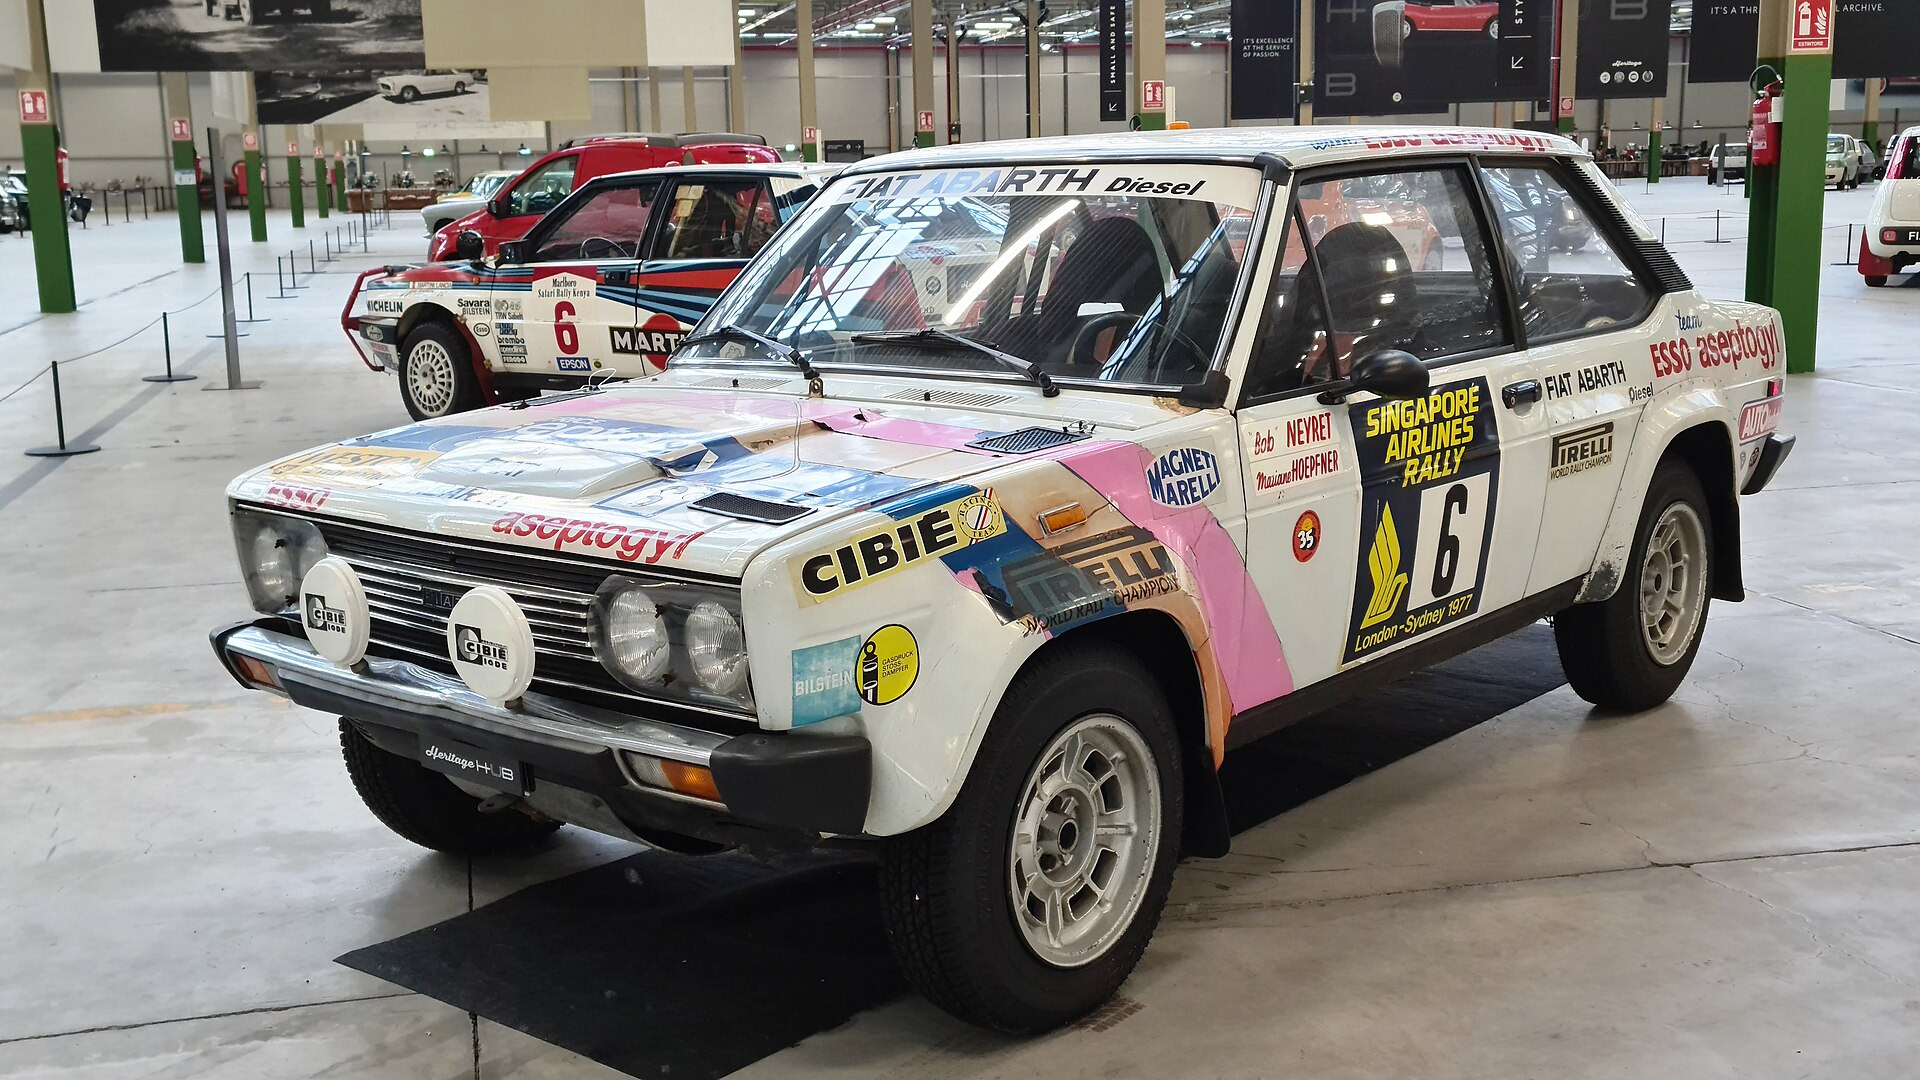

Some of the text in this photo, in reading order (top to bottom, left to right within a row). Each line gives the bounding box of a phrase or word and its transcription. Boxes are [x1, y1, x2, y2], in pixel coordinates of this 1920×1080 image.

[1710, 6, 1729, 15] IT'S
[1730, 6, 1737, 14] A
[1843, 3, 1885, 13] ARCHIVE.
[839, 167, 1206, 199] FIAT ABARTH Diesel
[1908, 231, 1920, 241] FI
[538, 288, 590, 299] Safari Rally Kenya
[552, 276, 577, 288] Marlboro
[458, 299, 490, 307] Savara
[462, 307, 491, 316] BILSTEIN
[554, 300, 579, 355] 6
[1675, 309, 1703, 331] team
[1650, 313, 1780, 378] ESSO aseptogyl
[560, 359, 588, 369] EPSON
[1545, 360, 1627, 400] FIAT ABARTH
[1628, 382, 1654, 403] Diesel
[1286, 412, 1331, 448] NEYRET
[1384, 415, 1474, 464] AIRLINES
[1551, 421, 1614, 468] PIRELLI
[1147, 448, 1220, 482] MAGNETI
[1291, 450, 1339, 482] HOEPFNER
[1402, 446, 1465, 488] RALLY
[1550, 454, 1612, 480] WORLD RALLY CHAMPION
[960, 497, 993, 517] RACING
[491, 511, 705, 564] aseptogyl
[973, 525, 995, 538] TEAM
[1297, 528, 1314, 549] 35
[1431, 483, 1468, 598] 6
[1114, 573, 1180, 606] CHAMPION
[1448, 593, 1473, 617] 1977
[882, 650, 914, 666] GASDRUCK
[795, 668, 853, 696] BILSTEIN
[425, 745, 514, 781] Heritage HUB
